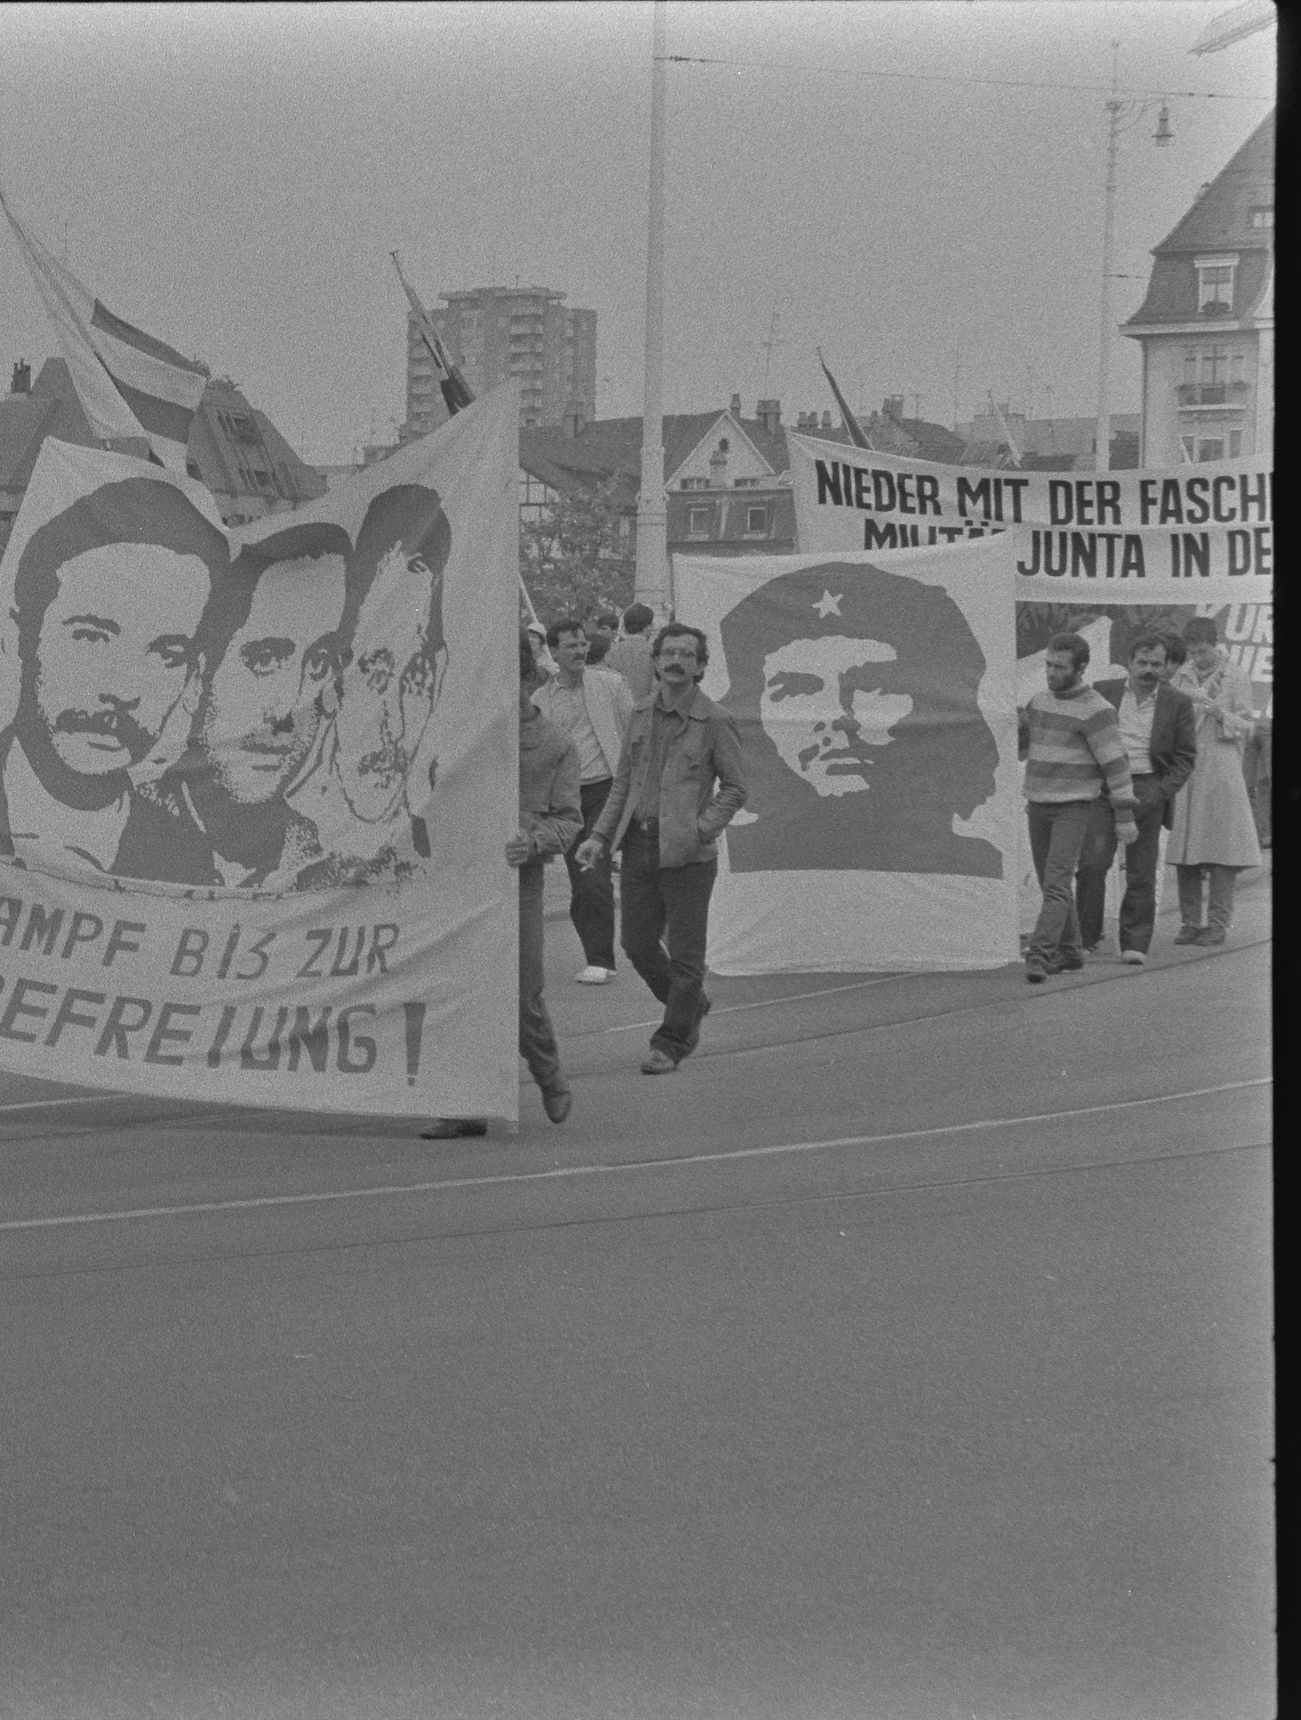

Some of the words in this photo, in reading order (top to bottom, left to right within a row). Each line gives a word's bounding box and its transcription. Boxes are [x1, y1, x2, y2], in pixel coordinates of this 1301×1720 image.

[814, 459, 943, 517] NIEDER
[956, 476, 1029, 524] MIT
[1048, 479, 1121, 525] DER
[1139, 472, 1273, 525] FASCH
[1016, 530, 1146, 578] JUNTA
[1170, 531, 1210, 578] IN
[296, 922, 400, 978] ZUR
